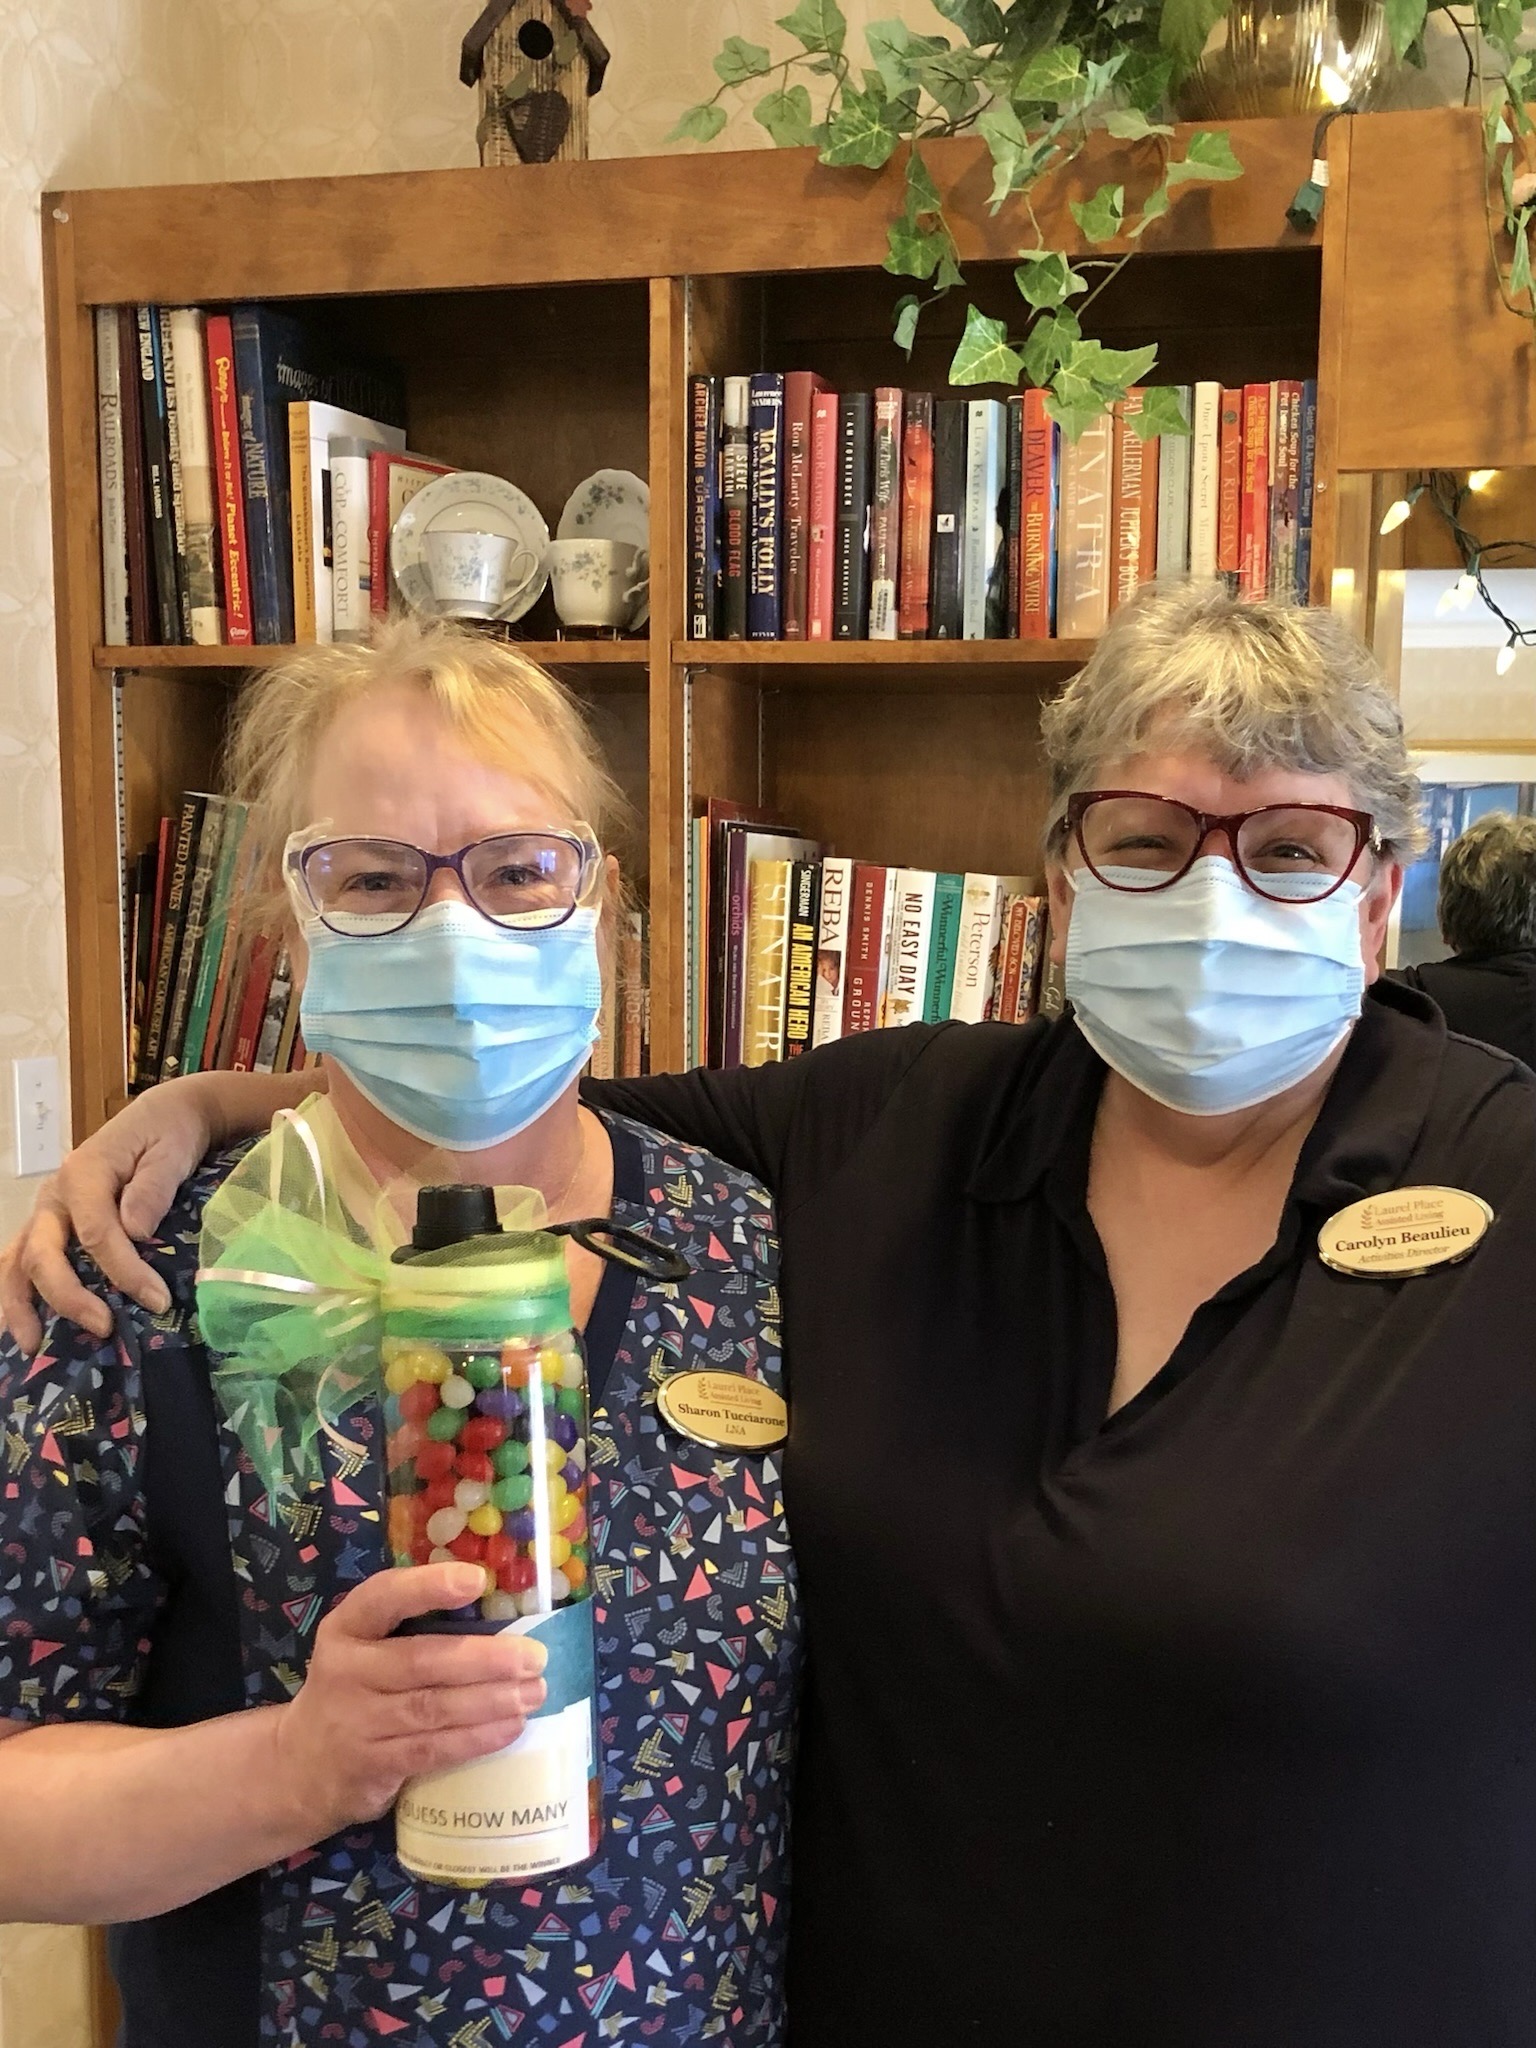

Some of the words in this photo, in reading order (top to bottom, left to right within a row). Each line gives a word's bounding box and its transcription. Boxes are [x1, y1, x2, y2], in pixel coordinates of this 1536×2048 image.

[137, 308, 151, 330] NEW
[139, 333, 154, 381] ENGLAND
[695, 383, 706, 428] ARCHER
[1202, 402, 1212, 430] Once
[1248, 396, 1257, 427] Chicken
[1280, 392, 1289, 406] Pet
[1290, 392, 1300, 429] Chicken
[100, 393, 118, 490] RAILROADS
[792, 422, 803, 447] Ron
[816, 424, 826, 460] BLOOD
[846, 422, 854, 436] AM
[880, 435, 891, 451] The
[914, 420, 922, 445] Monk
[1245, 427, 1256, 448] Soup
[1279, 410, 1288, 444] Lover's
[1288, 432, 1298, 455] Soup
[1306, 435, 1314, 449] Old
[695, 431, 706, 468] MAYOR
[1026, 429, 1046, 498] DEAVER
[1122, 431, 1143, 500] KELLERMAN
[1199, 434, 1212, 462] Upon
[1224, 440, 1236, 467] MY
[1278, 446, 1287, 467] Soul
[1289, 458, 1298, 472] for
[151, 465, 160, 484] BILL
[245, 443, 267, 499] NATURE
[724, 447, 734, 498] MARTINI
[736, 455, 748, 490] STEVE
[759, 428, 776, 528] McNALLY'S
[788, 453, 802, 510] McLarty
[844, 442, 853, 506] FORBIDDEN
[879, 454, 891, 478] Paris
[1288, 474, 1298, 490] the
[153, 485, 163, 518] HARRIS
[876, 480, 891, 503] Wife
[1199, 474, 1210, 509] Secret
[1301, 487, 1312, 517] Wimps
[225, 502, 238, 545] Planet
[695, 475, 706, 559] SURROGATE
[729, 509, 741, 545] BLOOD
[879, 517, 887, 549] PAULA
[906, 505, 915, 560] Invention
[1119, 507, 1140, 560] JUPITER'S
[1223, 477, 1236, 556] RUSSIAN
[790, 516, 801, 575] Traveler
[1026, 513, 1044, 577] BURNING
[336, 521, 348, 618] COMFORT
[729, 550, 741, 577] FLAG
[758, 537, 775, 597] FOLLY
[229, 549, 244, 619] Eccentric!
[695, 567, 704, 610] THIEF
[903, 580, 913, 616] Wings
[1025, 579, 1040, 615] WIRE
[1118, 565, 1139, 603] BONES
[182, 591, 190, 638] CRESCENT
[177, 803, 196, 862] PAINTED
[168, 863, 187, 911] PONIES
[798, 869, 812, 917] SINGERMAN
[864, 882, 873, 922] DENNIS
[905, 893, 923, 913] NO
[731, 895, 743, 936] orchids
[821, 868, 844, 945] REBA
[1014, 906, 1024, 918] MY
[792, 923, 813, 941] AN
[861, 927, 870, 960] SMITH
[901, 920, 920, 959] EASY
[1010, 919, 1022, 956] BELOVED
[158, 924, 176, 981] AMERICAN
[755, 883, 787, 1050] SINATR
[965, 912, 991, 988] Peterson
[789, 943, 813, 1006] AMERICAN
[898, 966, 917, 995] DAY
[151, 980, 167, 1037] CAROUSEL
[625, 974, 641, 1025] BIRDS
[1043, 986, 1060, 1010] Girls
[787, 1009, 809, 1040] HERO
[821, 1014, 830, 1040] REBA
[146, 1037, 158, 1060] ART
[1374, 1202, 1410, 1216] Laurel
[1413, 1199, 1444, 1211] Place
[1376, 1214, 1414, 1225] Assisted
[1415, 1211, 1445, 1221] Living
[1335, 1235, 1396, 1253] Carolyn
[1400, 1225, 1471, 1244] Beaulieu
[1358, 1250, 1405, 1264] Activities
[1406, 1245, 1451, 1258] Director
[708, 1380, 736, 1392] Laurel
[738, 1384, 759, 1395] Place
[678, 1403, 721, 1418] Sharon
[722, 1408, 785, 1426] Tucciarone
[725, 1424, 746, 1435] LNA
[453, 1811, 505, 1828] HOW
[511, 1801, 568, 1827] MANY
[513, 1863, 527, 1872] THE
